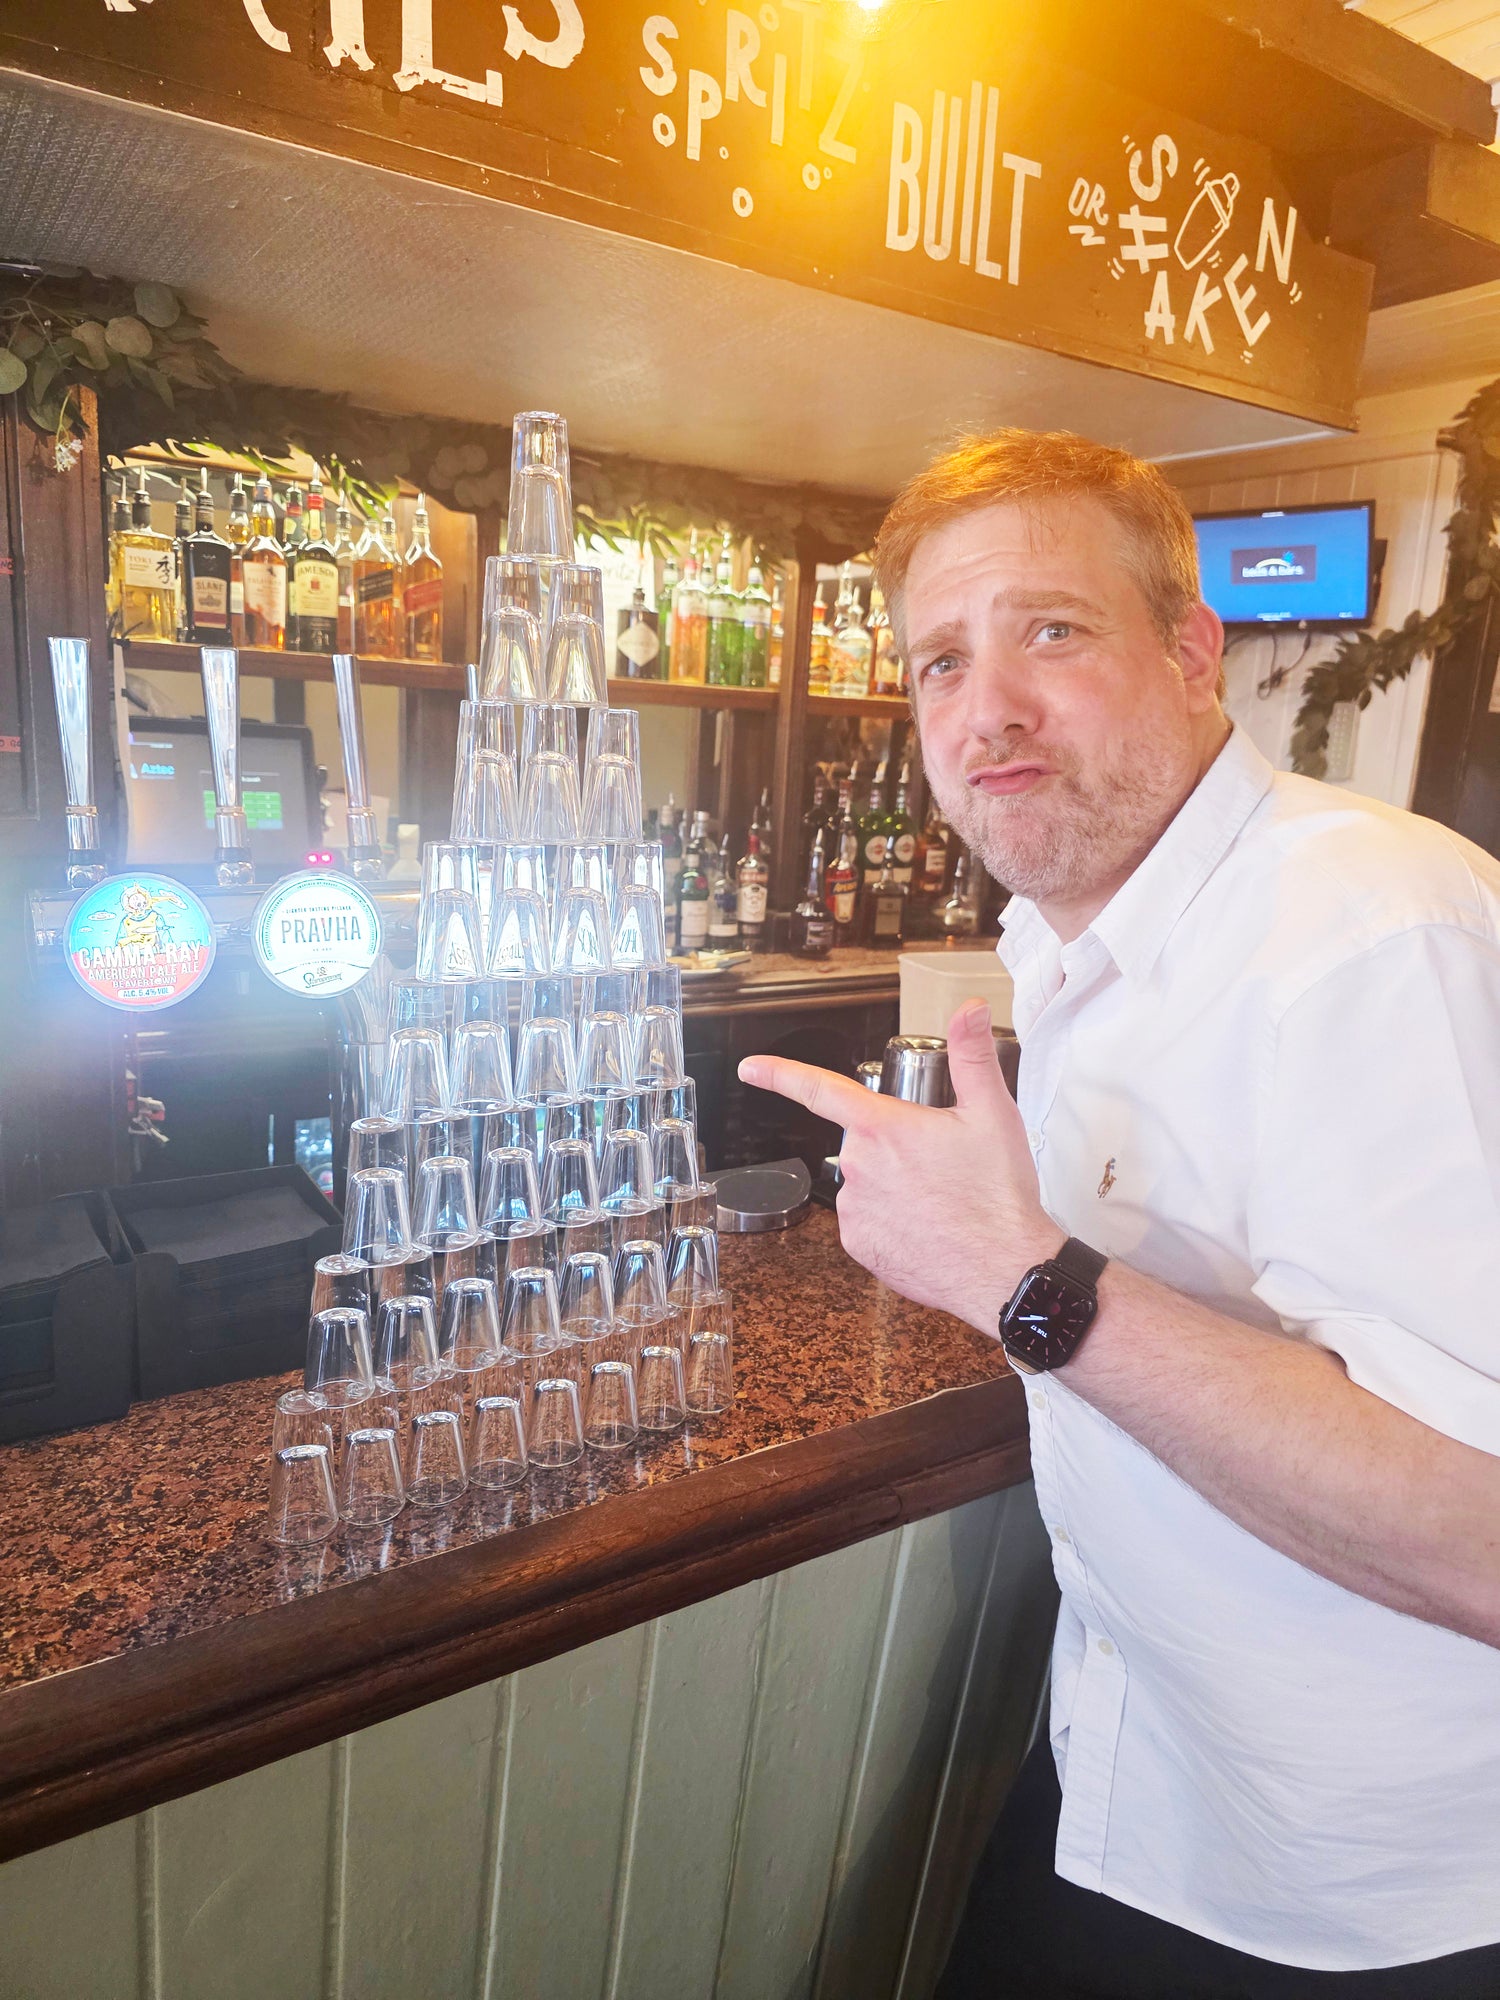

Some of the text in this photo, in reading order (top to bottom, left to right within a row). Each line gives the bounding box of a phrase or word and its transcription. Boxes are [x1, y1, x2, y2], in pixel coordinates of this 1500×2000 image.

[640, 0, 864, 163] SPRITZ
[885, 80, 1042, 286] BUILT
[1068, 177, 1109, 225] OR
[297, 566, 335, 578] JAMESON
[281, 915, 362, 944] PRAVHA
[79, 938, 201, 969] GAMMA RAY
[88, 961, 200, 981] AMERICAN PALE ALE
[112, 976, 177, 988] BEAVERTOWN
